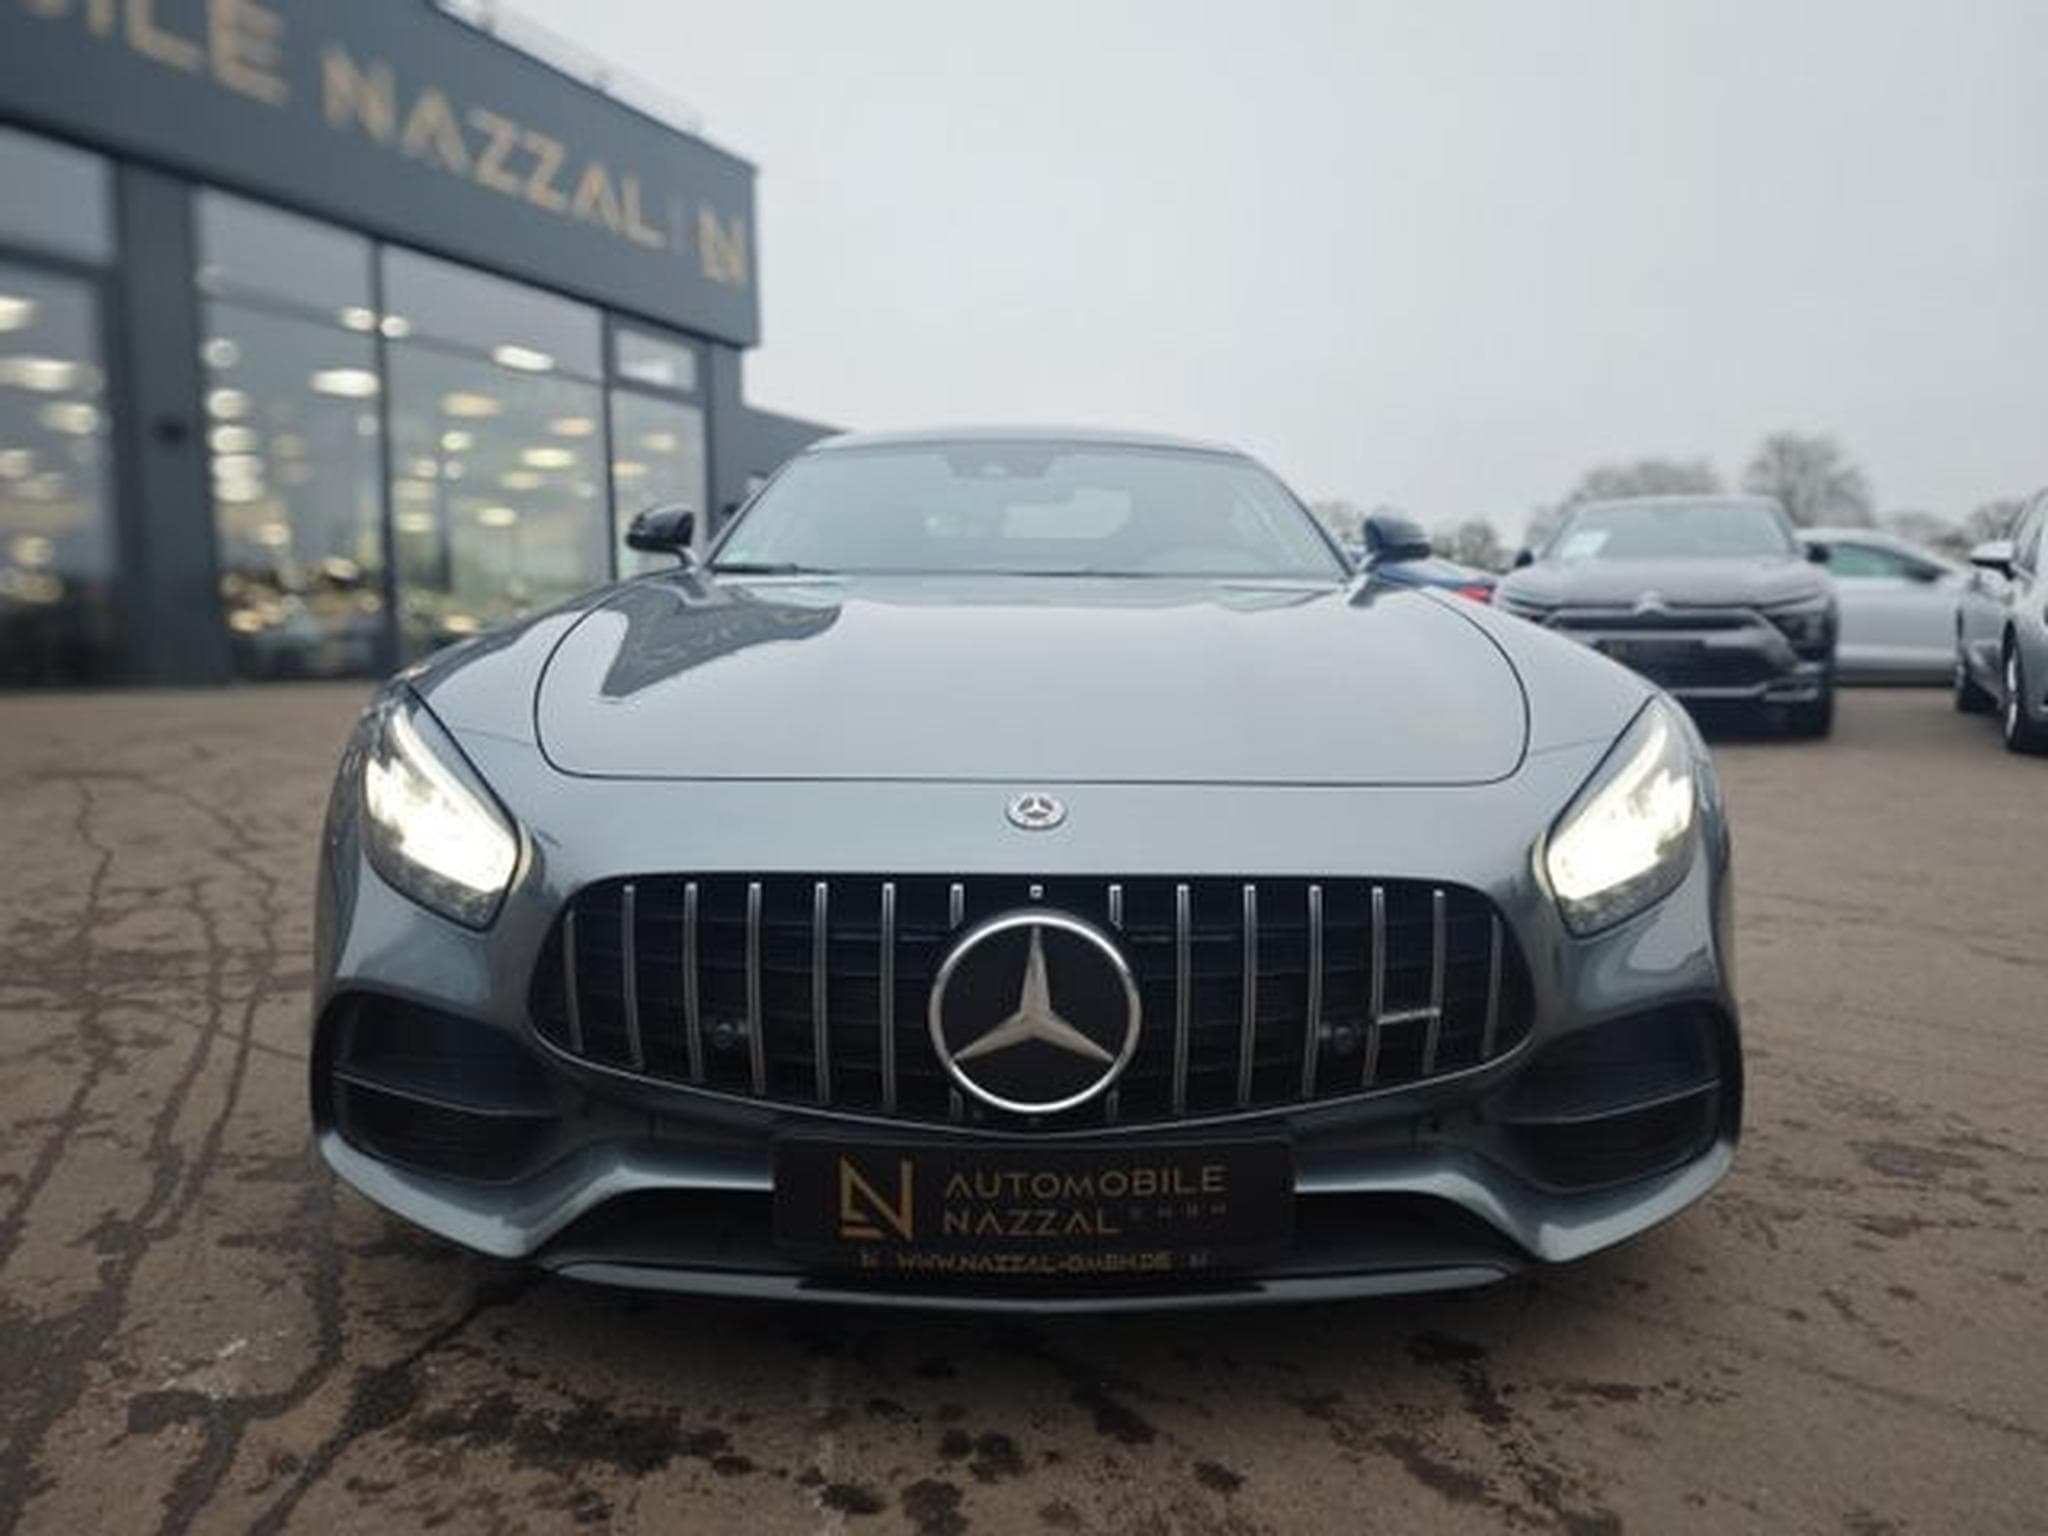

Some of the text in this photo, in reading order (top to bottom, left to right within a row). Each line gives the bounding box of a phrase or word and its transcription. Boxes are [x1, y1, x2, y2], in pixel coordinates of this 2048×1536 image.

[321, 46, 668, 252] NAZZAL
[944, 1165, 1229, 1199] AUTOMOBILE
[944, 1209, 1122, 1237] NAZZAL
